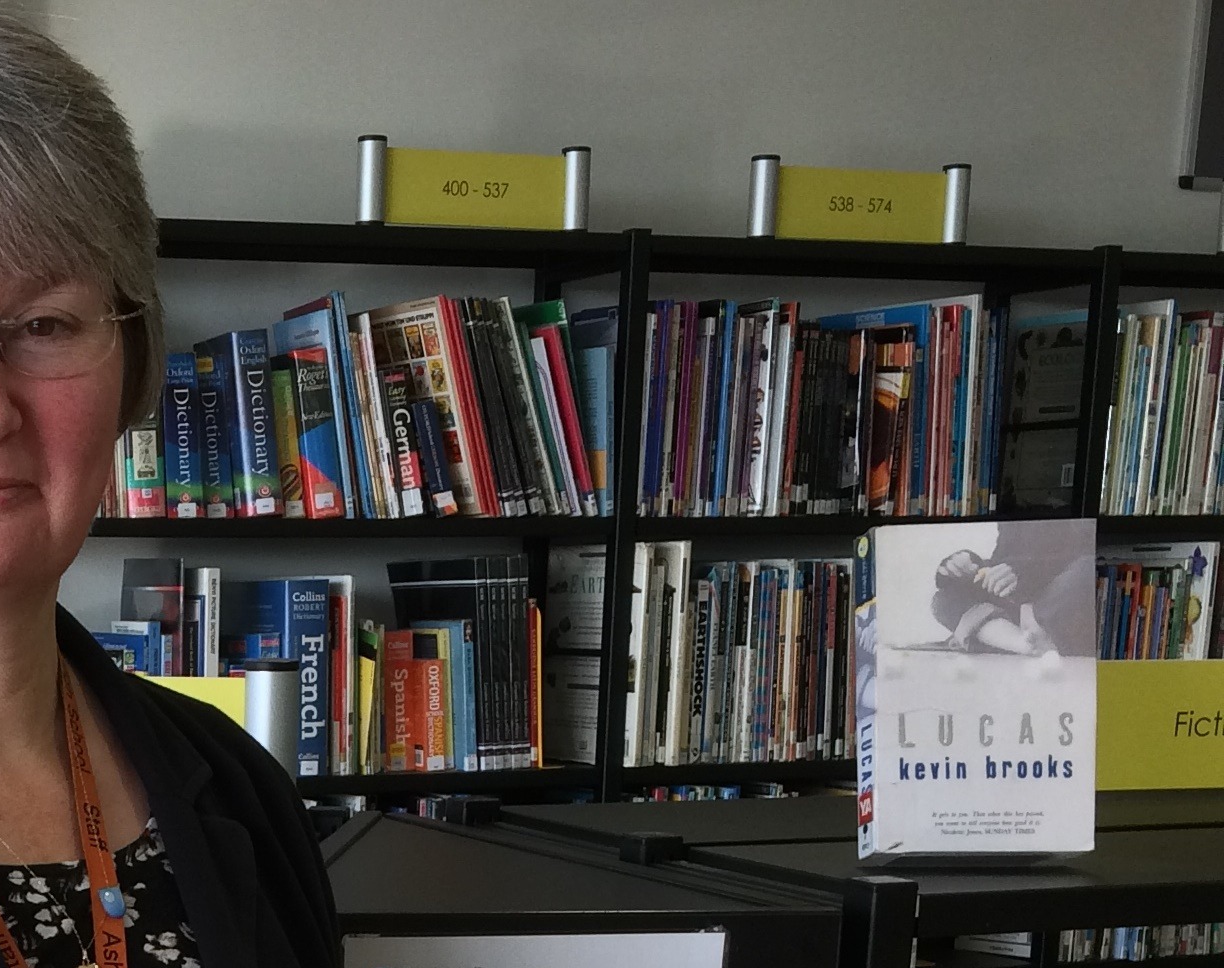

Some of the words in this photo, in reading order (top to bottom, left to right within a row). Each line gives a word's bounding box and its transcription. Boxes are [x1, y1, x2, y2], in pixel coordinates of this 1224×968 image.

[442, 181, 469, 197] 400
[483, 182, 508, 199] 537
[829, 196, 854, 213] 538
[866, 198, 892, 215] 574
[240, 345, 266, 355] Oxford
[240, 355, 267, 366] English
[166, 367, 193, 377] Oxford
[173, 387, 193, 488] Dictionary
[201, 391, 221, 488] Dictionary
[247, 369, 271, 478] Dictionary
[392, 407, 416, 489] German
[292, 592, 325, 602] Collins
[293, 603, 325, 612] ROBERT
[692, 601, 708, 717] EARTHSHOCK
[301, 634, 325, 740] French
[390, 668, 411, 745] Spanish
[428, 665, 440, 711] OXFORD
[898, 712, 1074, 748] LUCAS
[1174, 710, 1224, 738] Fict
[860, 723, 873, 793] LUCAS
[899, 756, 967, 780] kevin
[985, 754, 1073, 779] brooks
[82, 802, 109, 853] Staff
